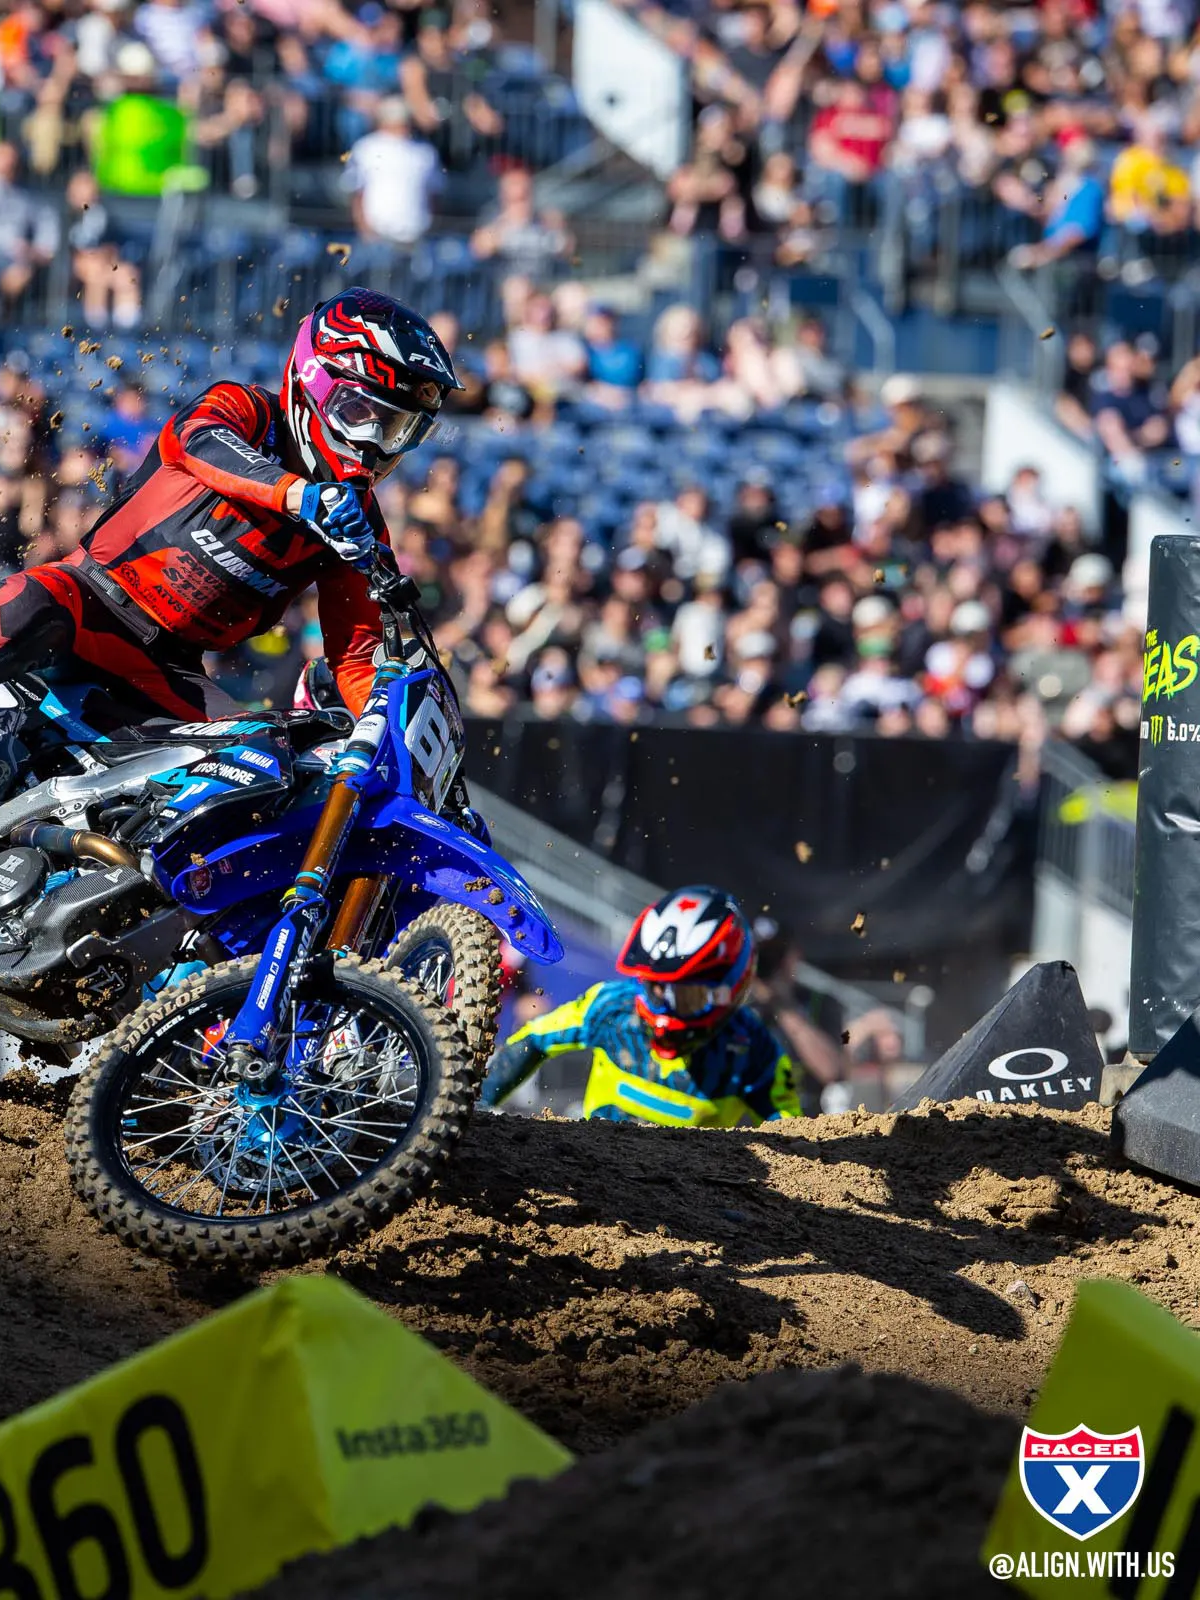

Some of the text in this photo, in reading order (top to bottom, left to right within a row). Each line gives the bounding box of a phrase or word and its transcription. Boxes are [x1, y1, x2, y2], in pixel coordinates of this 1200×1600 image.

[191, 529, 289, 598] CLUBMX
[239, 750, 274, 769] YAMAHA
[126, 984, 207, 1049] DUNLOP
[976, 1076, 1093, 1103] OAKLEY
[337, 1409, 489, 1462] Insta360
